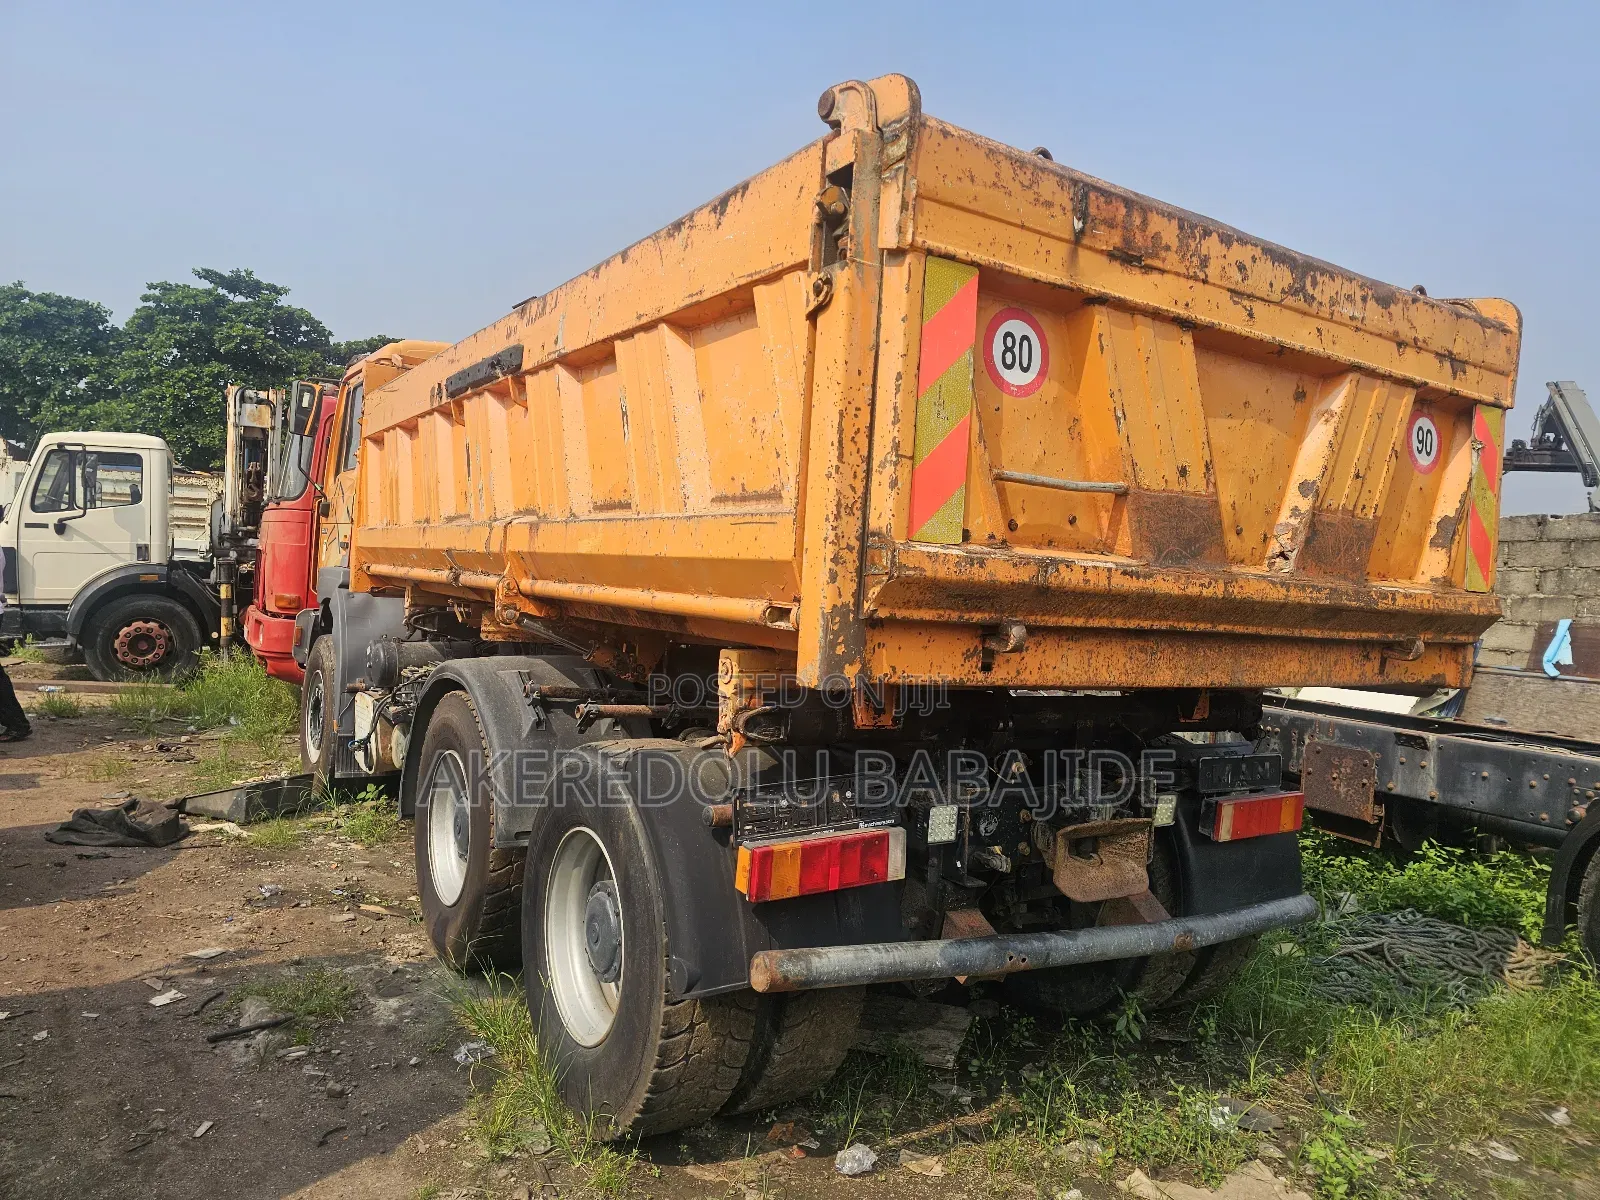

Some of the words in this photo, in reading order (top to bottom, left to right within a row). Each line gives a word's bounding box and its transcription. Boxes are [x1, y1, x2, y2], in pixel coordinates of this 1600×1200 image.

[1001, 331, 1033, 373] 80
[1416, 426, 1433, 457] 90
[1212, 760, 1271, 785] MAN
